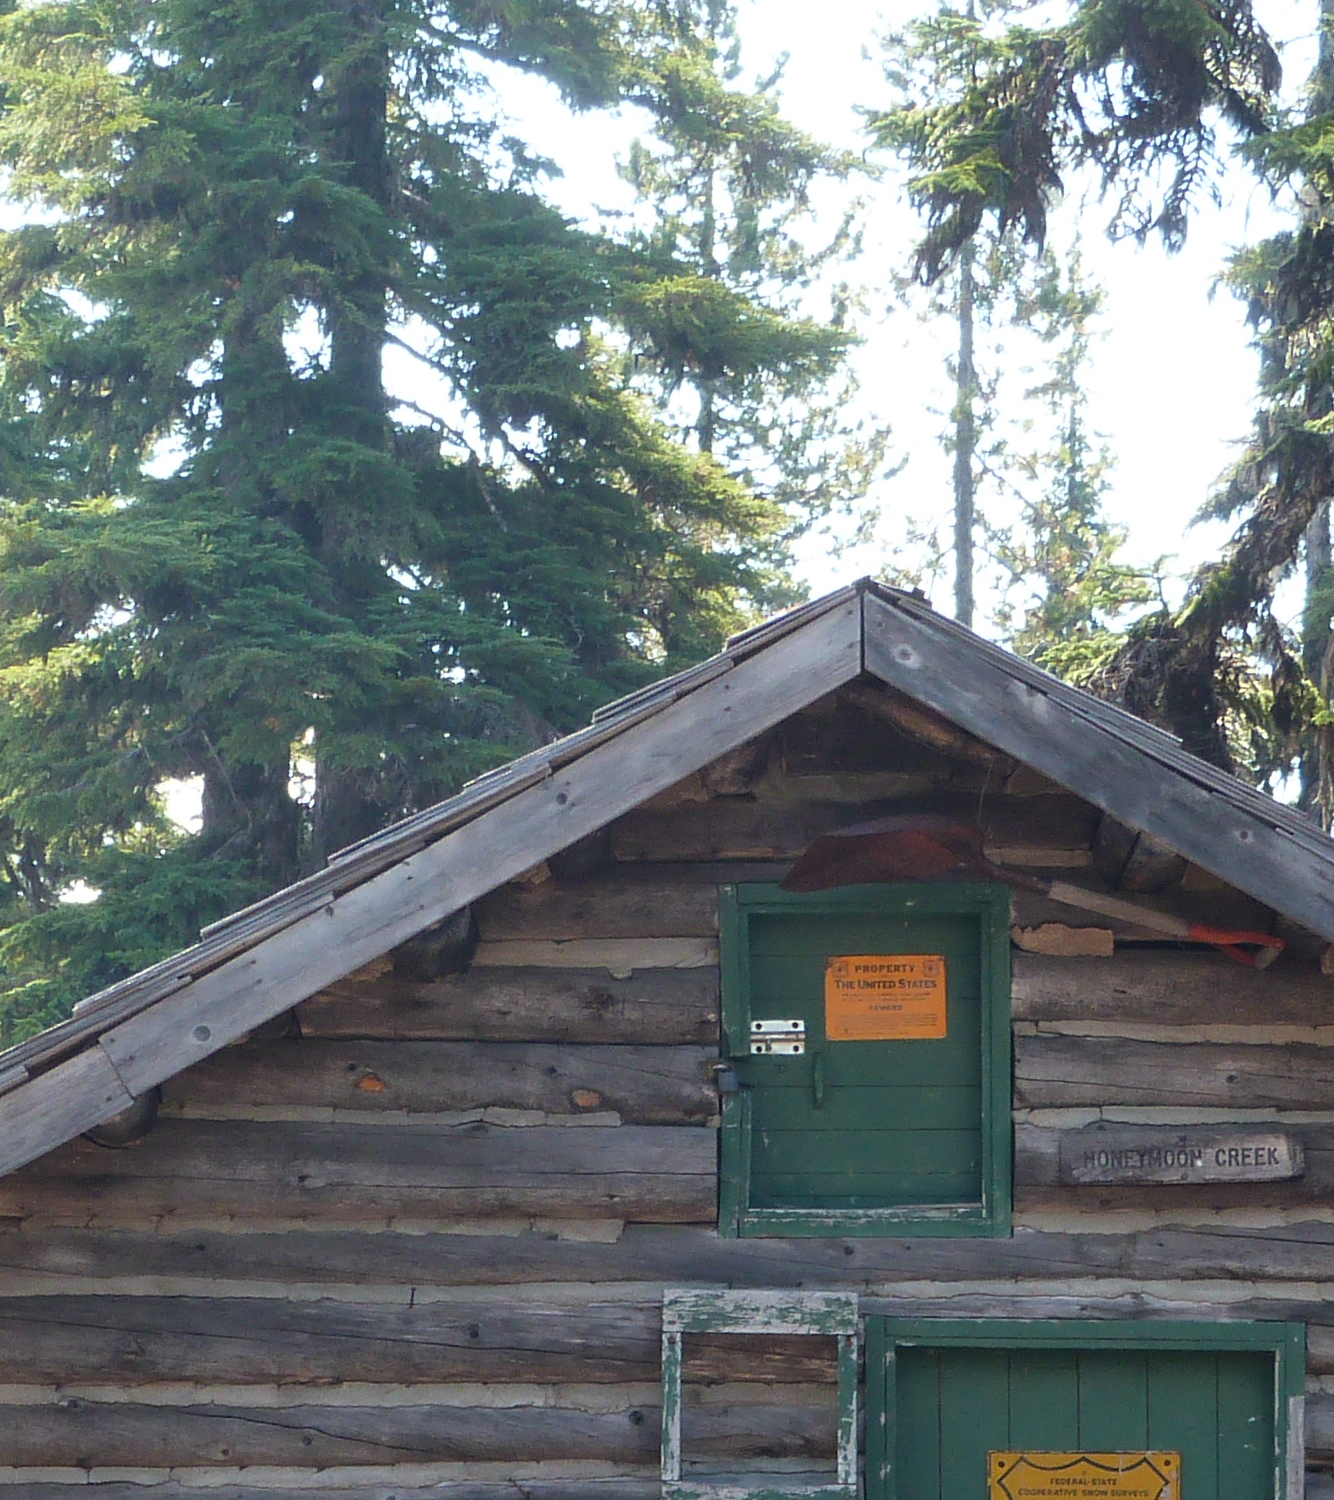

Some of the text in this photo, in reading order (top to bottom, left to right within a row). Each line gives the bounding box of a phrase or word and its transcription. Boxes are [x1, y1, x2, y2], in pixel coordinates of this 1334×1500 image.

[854, 964, 916, 974] PROPERTY
[835, 978, 937, 989] THE UNITED STATES
[1082, 1147, 1279, 1169] HONEYMOON CREEK
[1018, 1489, 1149, 1497] COOPERATIVE SNOW SURVEYS
